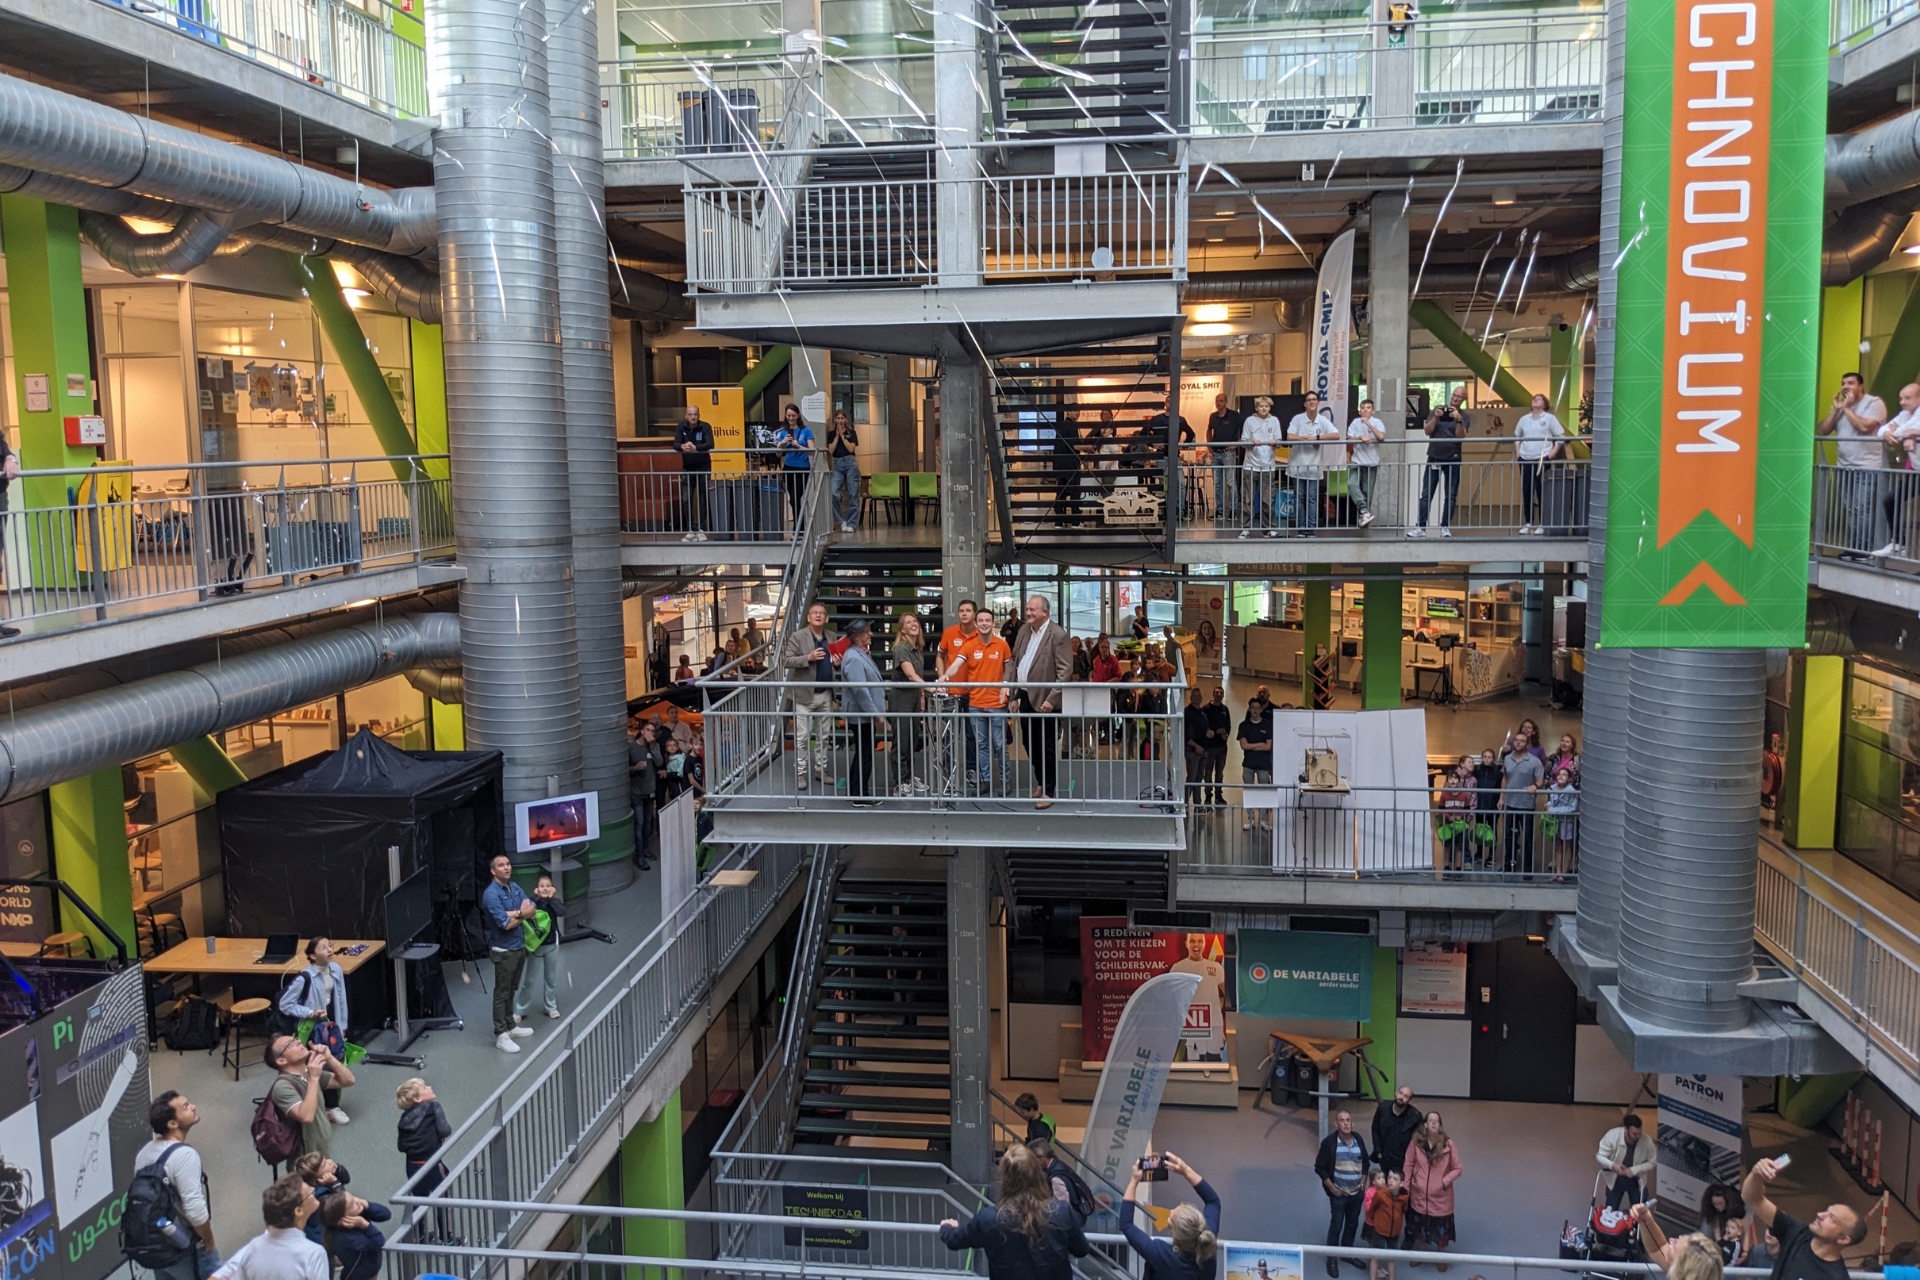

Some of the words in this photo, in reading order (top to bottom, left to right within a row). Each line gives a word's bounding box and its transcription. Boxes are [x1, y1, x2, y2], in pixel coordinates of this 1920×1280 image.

[1675, 3, 1757, 453] CHNOVIUM
[1320, 291, 1333, 336] SMIT
[1317, 340, 1329, 402] ROYAL
[1337, 393, 1344, 401] of
[711, 426, 740, 437] ijhuis
[957, 585, 968, 593] dm
[0, 897, 32, 908] ORLD
[0, 912, 33, 927] NXP
[1094, 929, 1100, 937] 5
[1103, 929, 1151, 938] REDENEN
[1094, 939, 1112, 948] OM
[1116, 939, 1126, 948] TE
[1130, 939, 1166, 948] KIEZEN
[1095, 950, 1126, 959] VOOR
[1129, 950, 1141, 959] DE
[1095, 961, 1168, 970] SCHILDERSVAK-
[1095, 972, 1152, 981] OPLEIDING
[1273, 969, 1288, 978] DE
[1292, 970, 1359, 982] VARIABELE
[1183, 1010, 1209, 1027] NL
[53, 1015, 74, 1050] Pi
[963, 1026, 974, 1034] dm
[1675, 1075, 1723, 1102] PATRON
[1110, 1046, 1152, 1151] VARIABELE
[1103, 1154, 1121, 1181] DE
[806, 1192, 834, 1200] Welkom
[835, 1193, 844, 1201] bij
[785, 1206, 865, 1219] TECHNIEKDAG
[5, 1228, 55, 1280] CON
